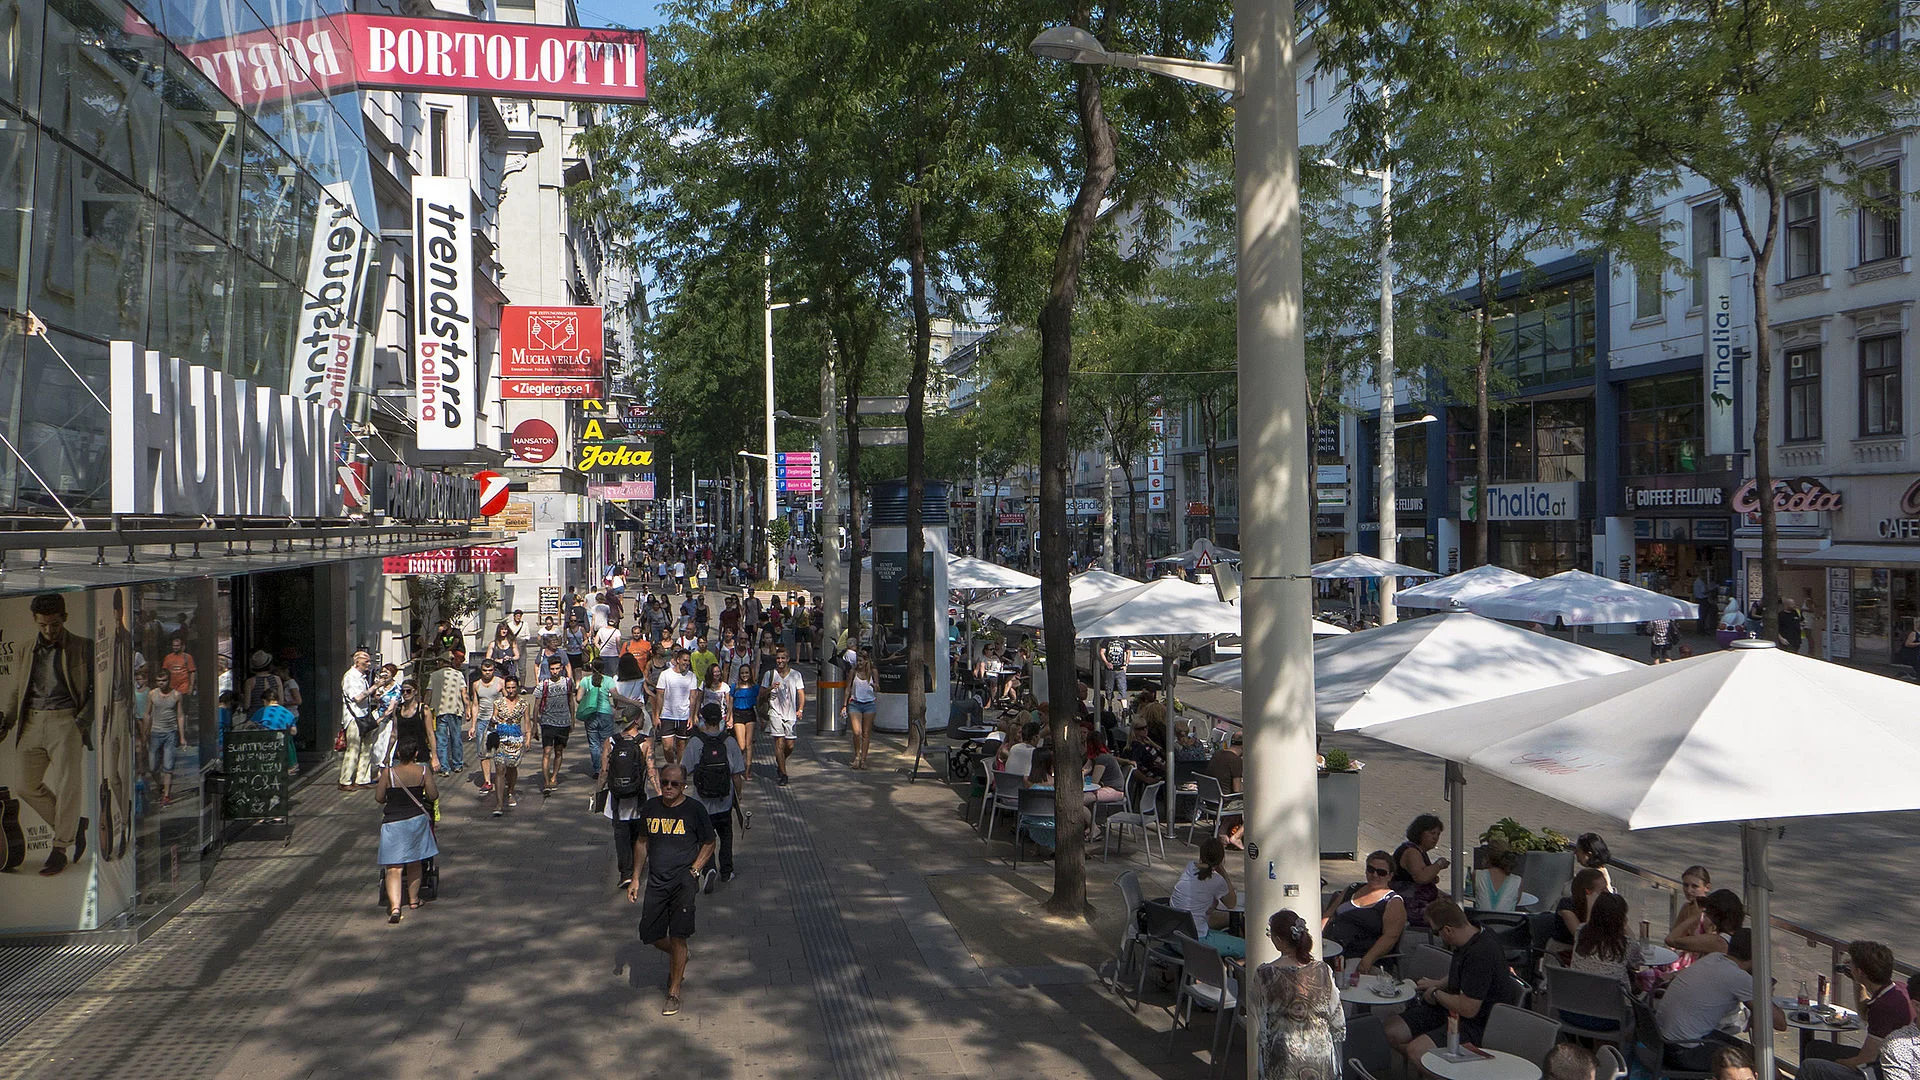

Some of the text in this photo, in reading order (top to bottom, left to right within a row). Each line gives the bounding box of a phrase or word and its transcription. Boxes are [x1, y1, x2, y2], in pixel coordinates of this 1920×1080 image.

[367, 26, 639, 88] BORTOLOTTI
[428, 202, 470, 429] trendstore
[421, 342, 440, 421] balina
[520, 382, 590, 397] Zieglergasse 1
[110, 341, 344, 517] HUMANIC
[513, 437, 554, 445] HANSATON
[578, 445, 653, 472] Joka
[1399, 498, 1424, 511] FELLOWS
[1487, 486, 1567, 517] Thalia.at
[1637, 487, 1722, 506] COFFEE FELLOWS
[400, 549, 502, 558] ELATERIA
[408, 558, 491, 574] BORTOLOTTI
